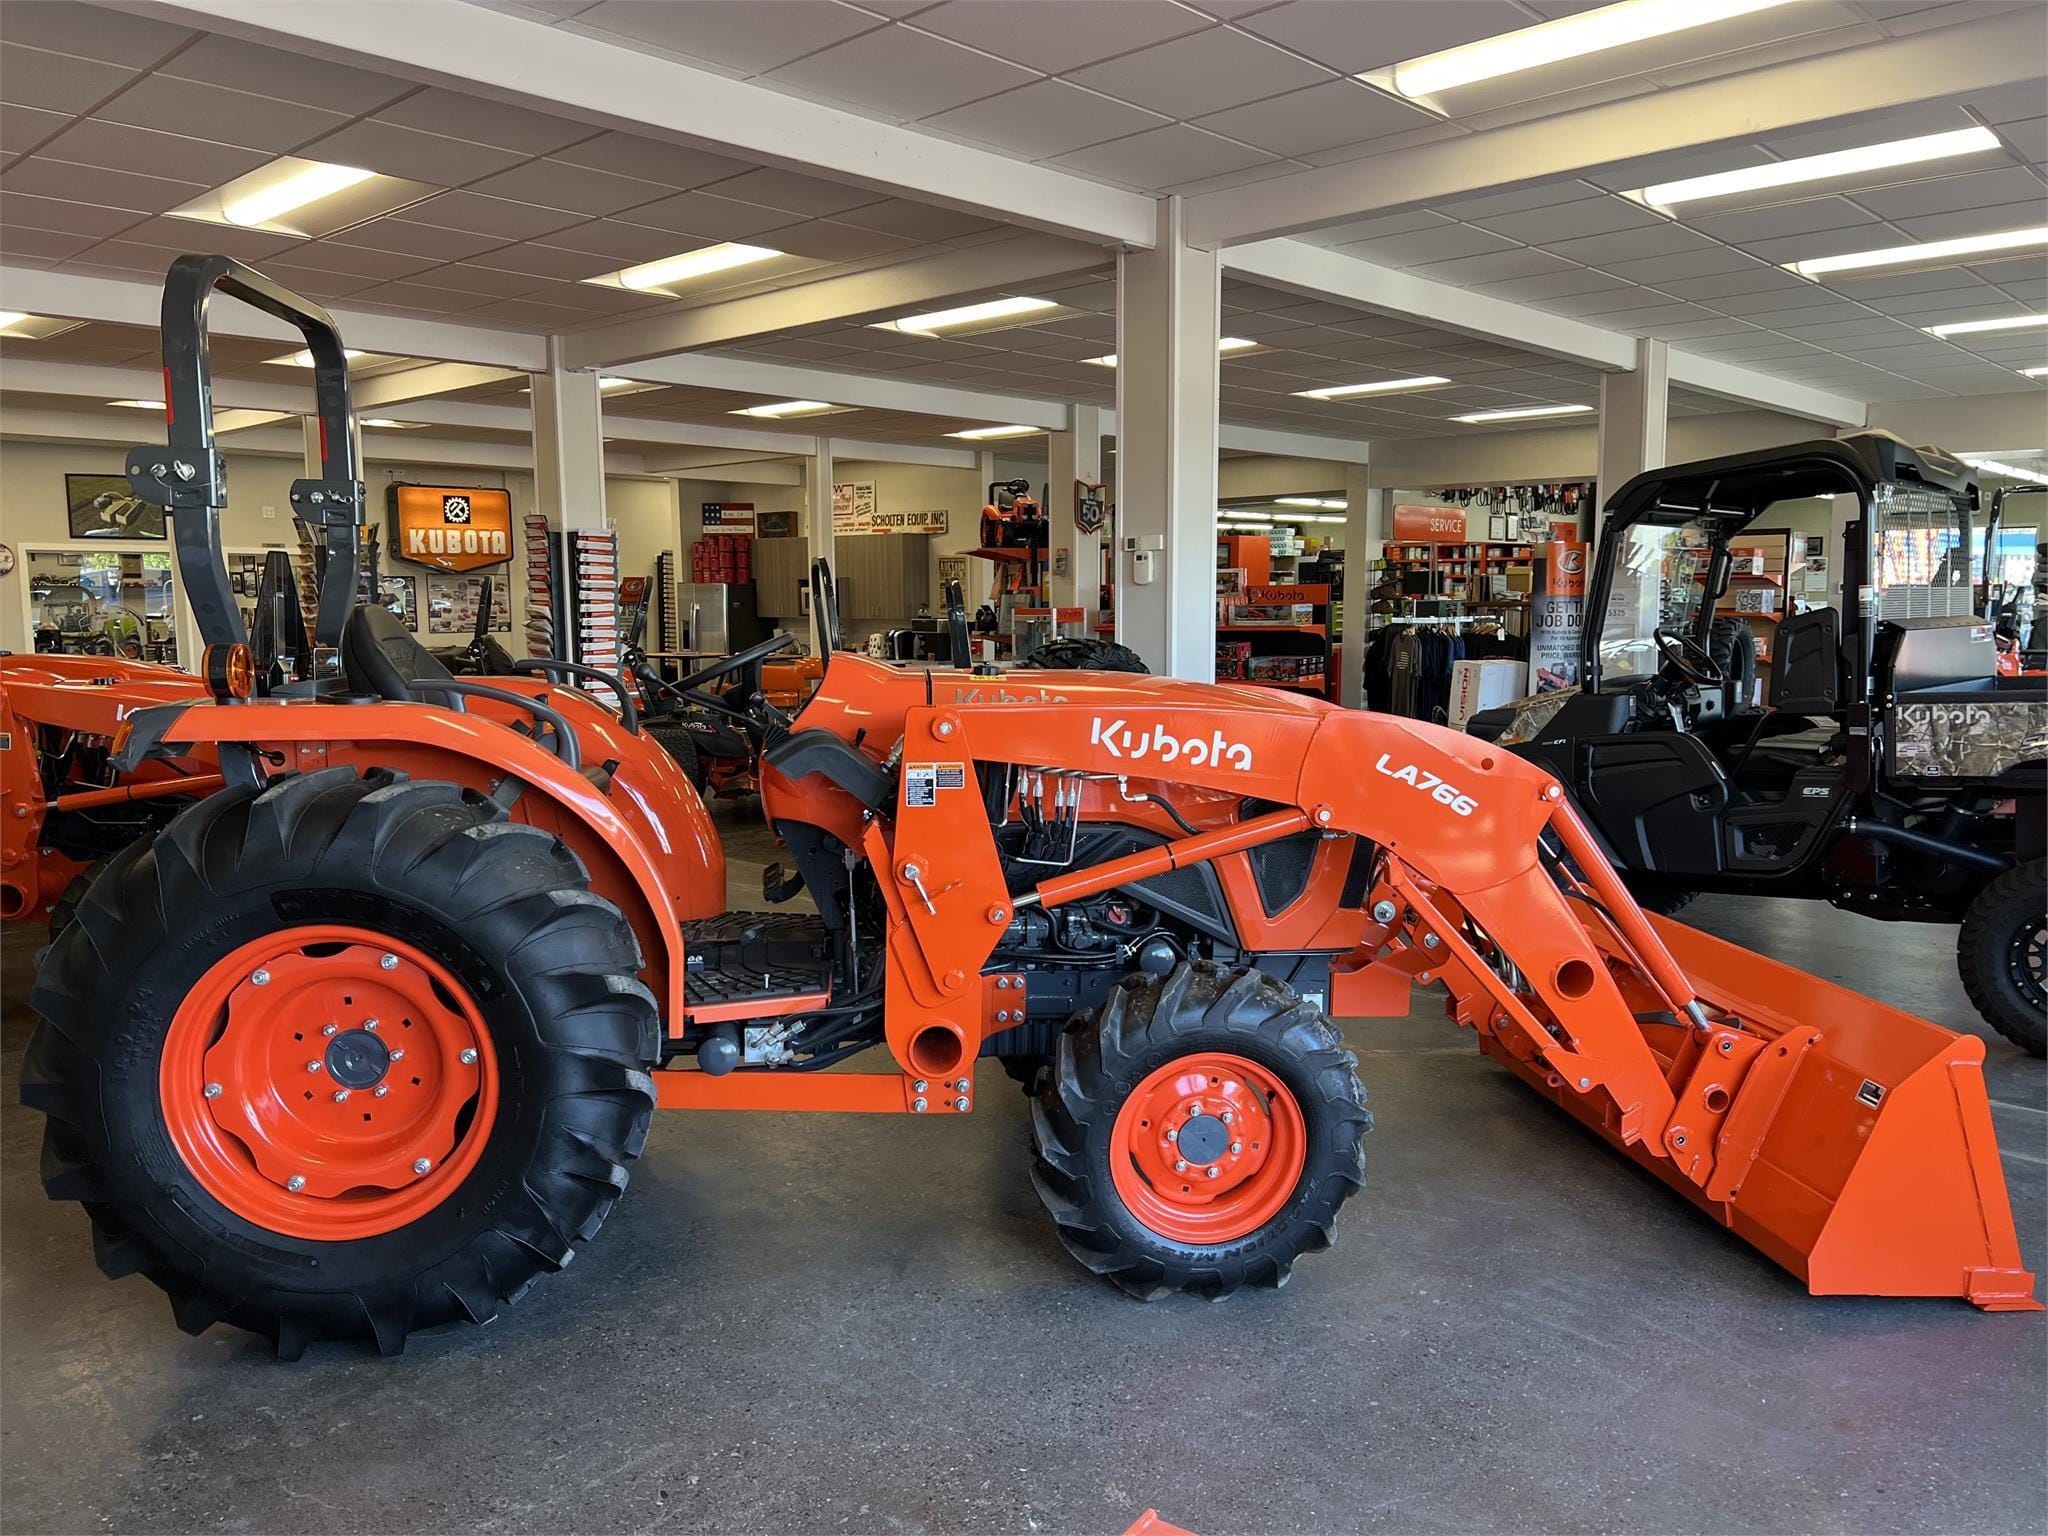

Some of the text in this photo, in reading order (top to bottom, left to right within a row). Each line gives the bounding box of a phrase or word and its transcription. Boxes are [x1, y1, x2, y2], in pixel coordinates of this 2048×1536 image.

[872, 514, 905, 527] SCHOLTEN
[1083, 504, 1099, 522] 50
[1430, 518, 1462, 533] SERVICE
[409, 529, 506, 555] KUBOTA
[1261, 589, 1305, 601] Kubota
[1546, 601, 1571, 614] GET
[1536, 615, 1563, 627] JOB
[1897, 704, 1991, 728] Kubota
[1091, 716, 1253, 771] Kubota
[1376, 753, 1479, 816] LA766
[1802, 787, 1831, 796] EPS
